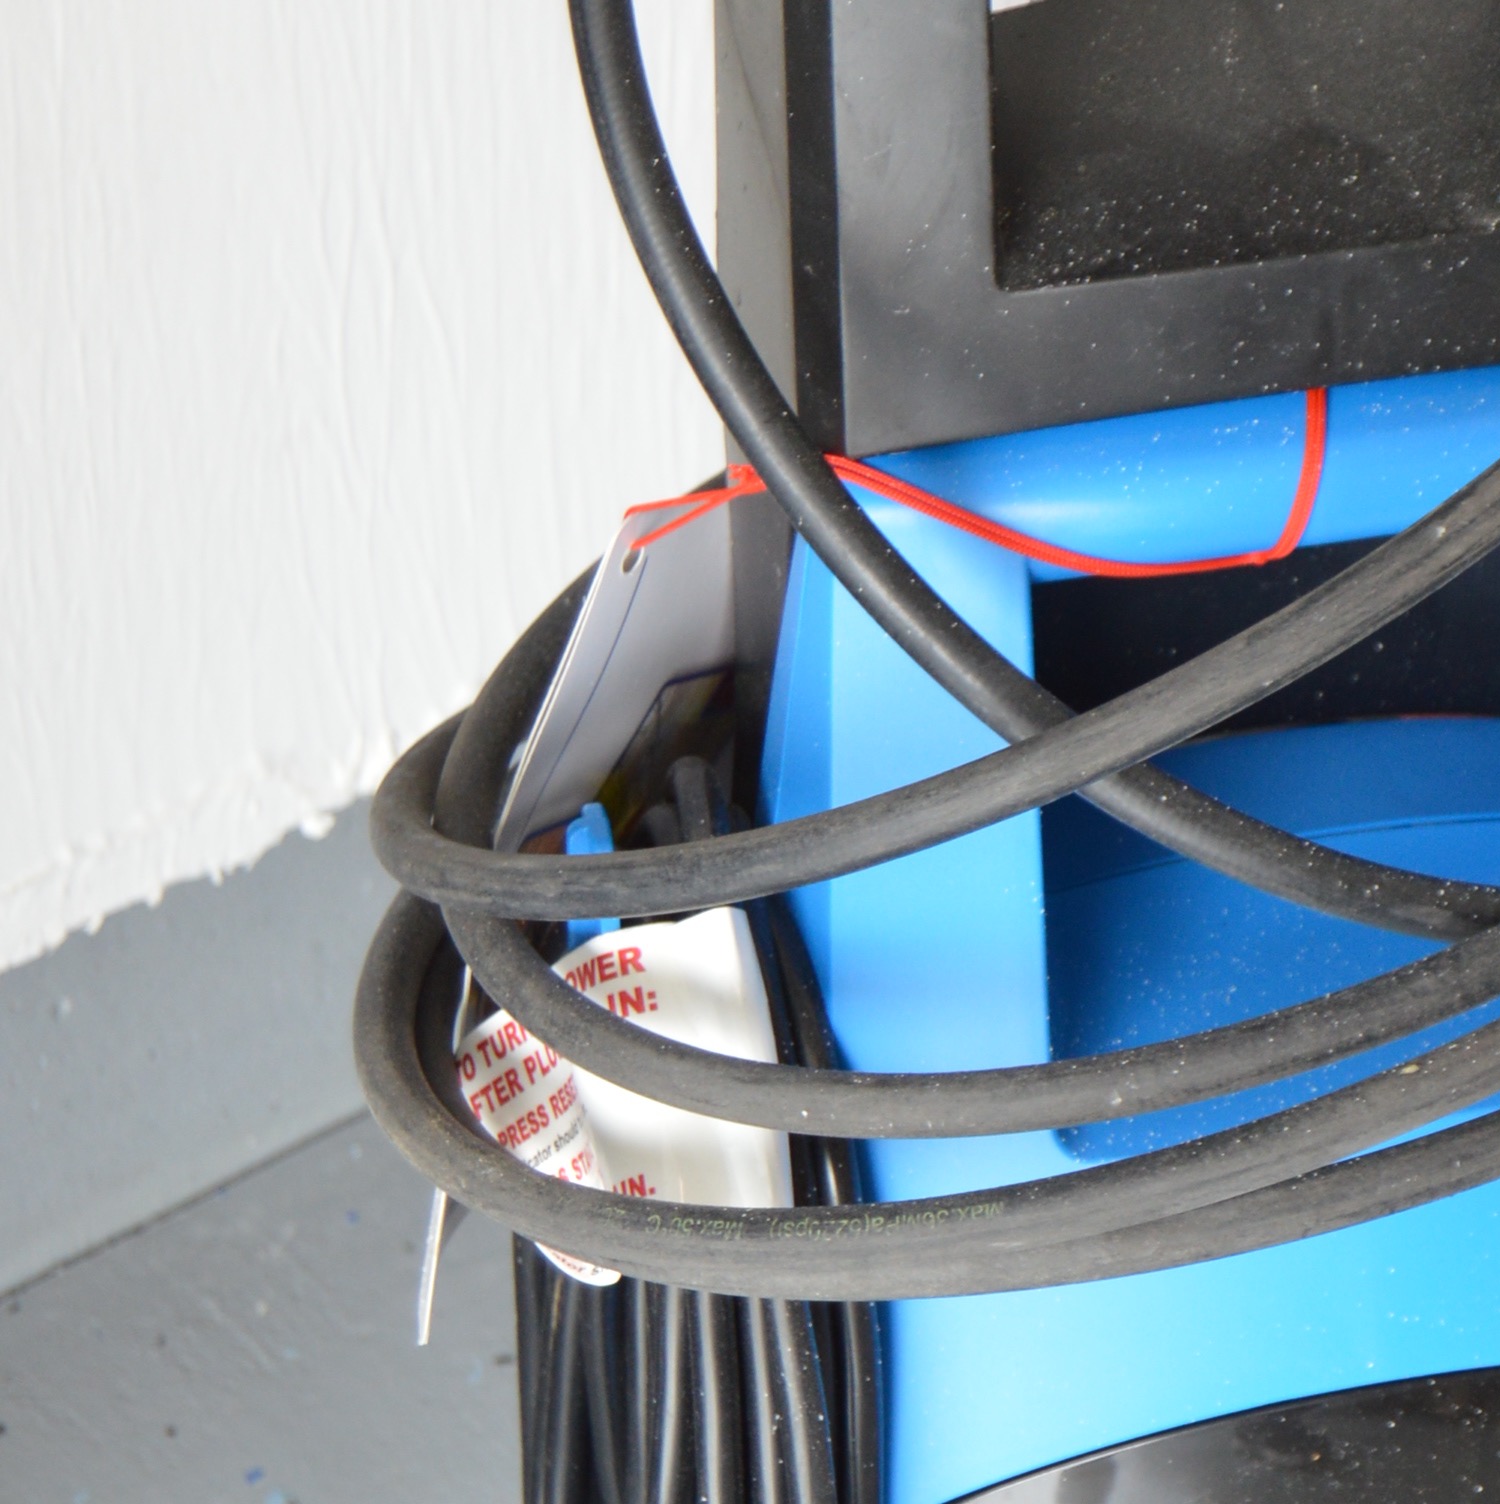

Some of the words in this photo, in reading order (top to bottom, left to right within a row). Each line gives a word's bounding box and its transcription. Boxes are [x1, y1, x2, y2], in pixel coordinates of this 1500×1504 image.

[565, 946, 646, 992] OWER
[469, 1067, 525, 1121] FTER
[522, 1042, 564, 1086] PLU
[497, 1103, 550, 1149] PRESS
